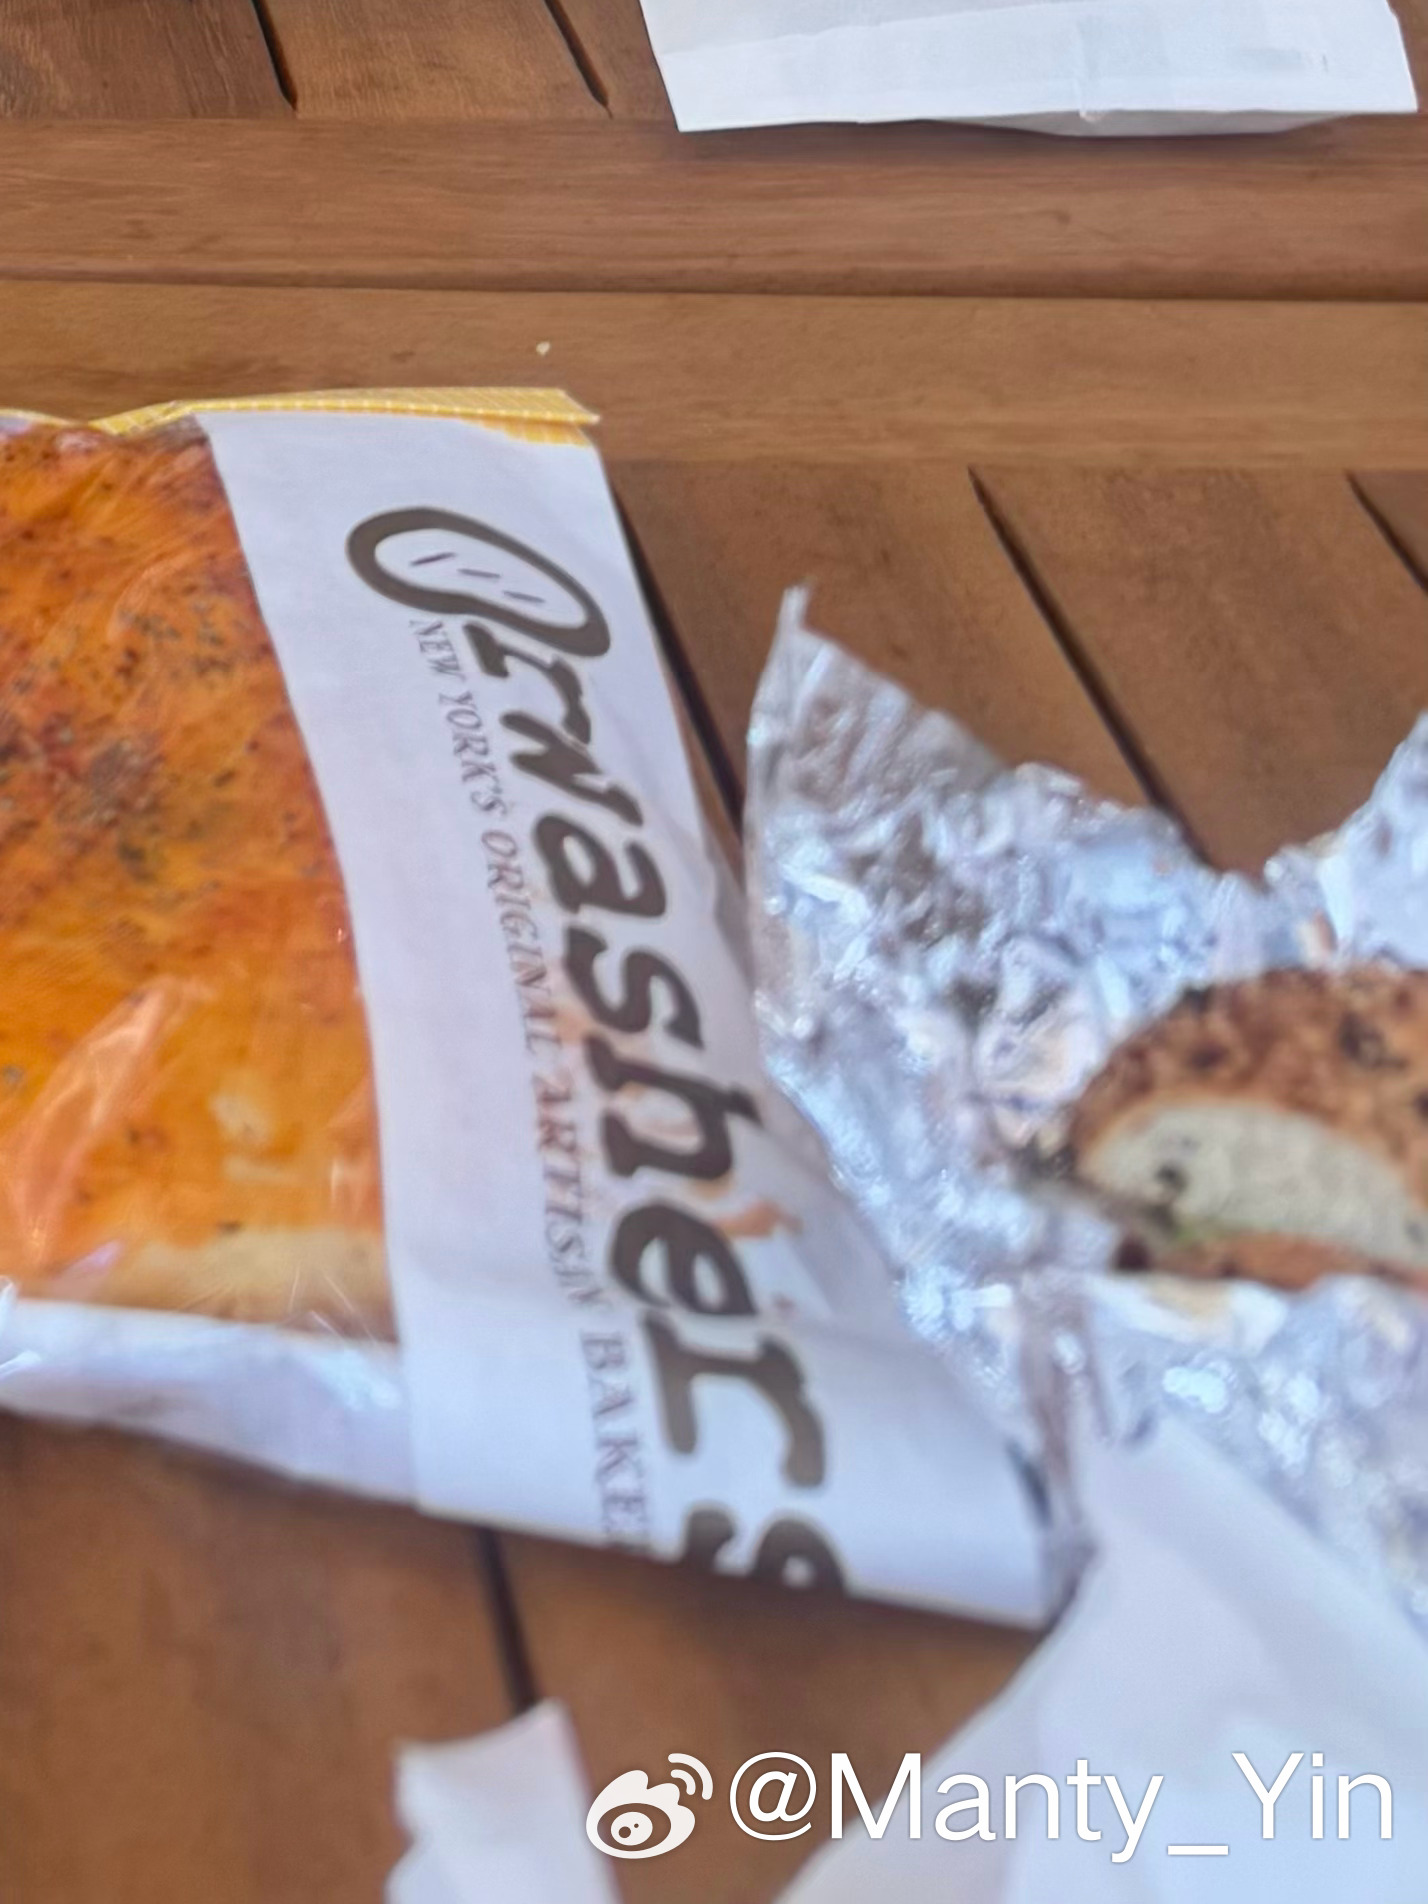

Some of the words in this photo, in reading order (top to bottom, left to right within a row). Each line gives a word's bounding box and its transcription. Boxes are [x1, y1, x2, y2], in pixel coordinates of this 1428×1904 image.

[409, 618, 466, 685] NEW
[438, 685, 510, 822] YORK'S
[480, 827, 563, 1053] ORIGINAL
[531, 1070, 613, 1316] ARTISAN
[578, 1328, 650, 1550] BAKE
